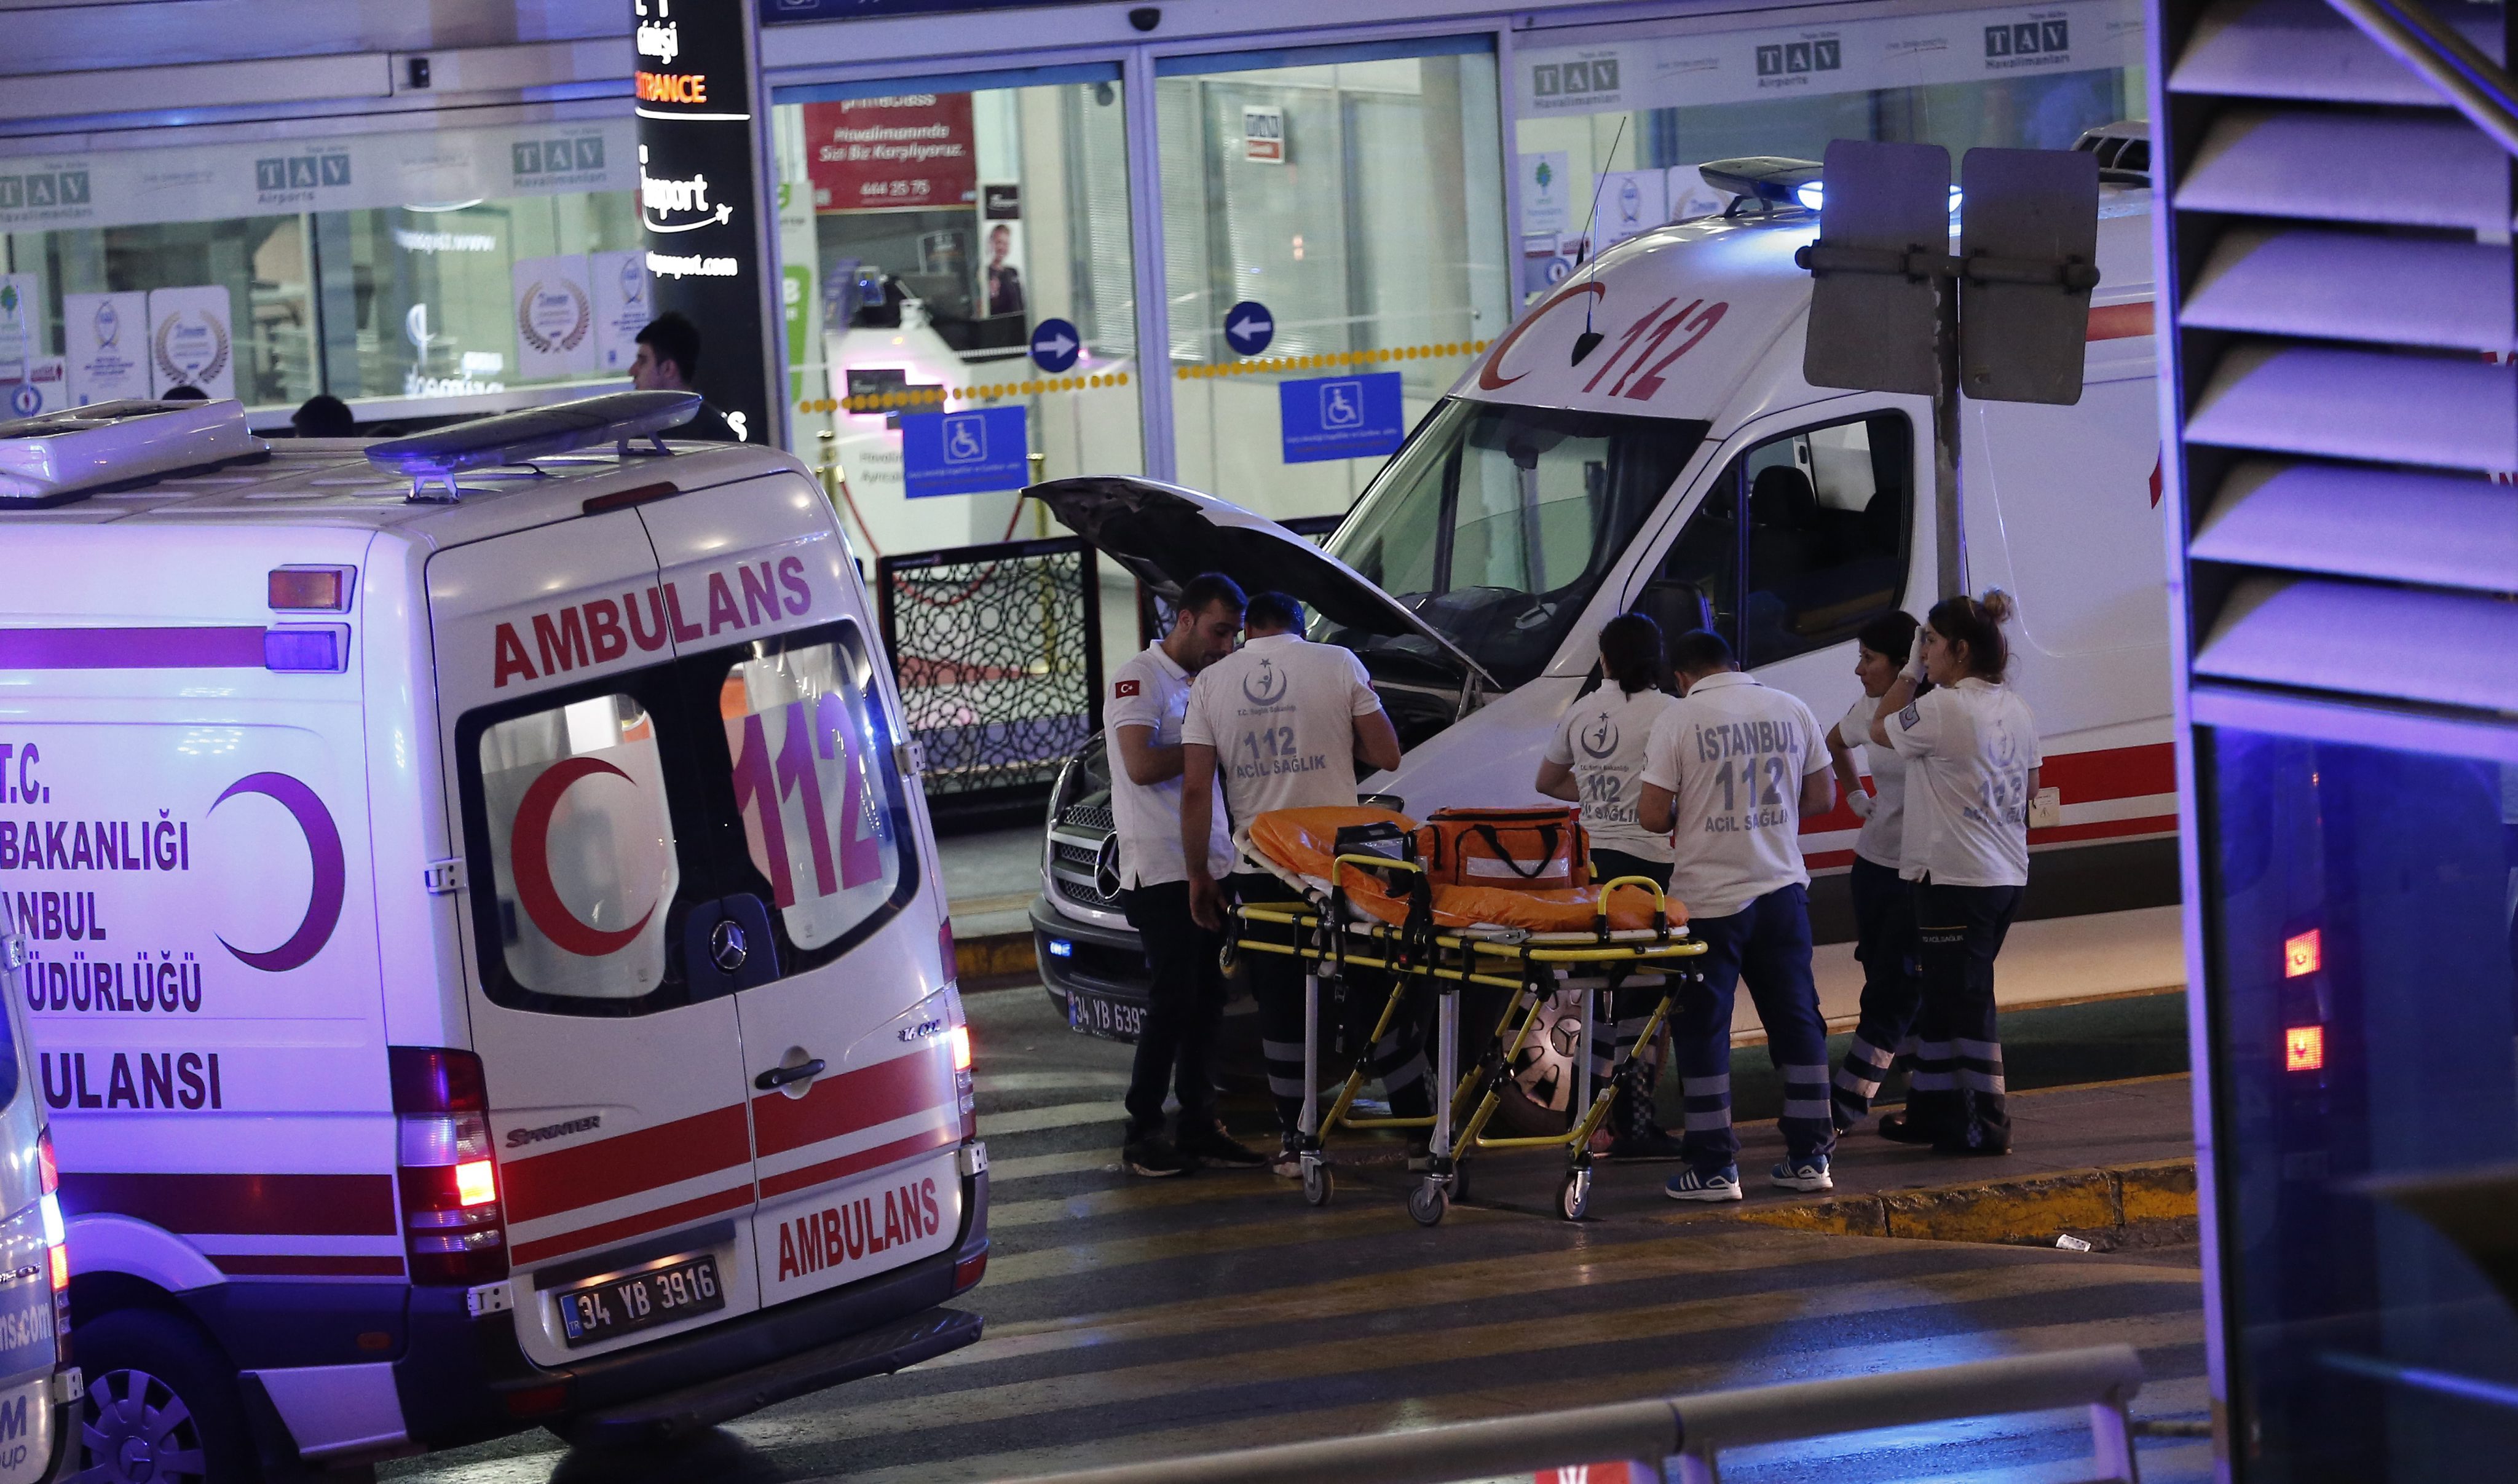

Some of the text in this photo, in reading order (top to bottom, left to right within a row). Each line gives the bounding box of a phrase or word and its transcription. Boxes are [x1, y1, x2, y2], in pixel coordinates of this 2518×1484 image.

[1756, 40, 1840, 75] TAV
[1986, 20, 2068, 57] TAV
[1534, 60, 1619, 97] TAV
[255, 154, 351, 191] TAV
[512, 137, 604, 174] TAV
[1582, 297, 1729, 401] 112
[494, 556, 811, 688] AMBULANS
[1244, 727, 1296, 759] 112
[1695, 721, 1798, 763] İSTANBUL
[0, 743, 50, 804] T.C.
[1274, 756, 1326, 775] SAĞLIK
[1716, 757, 1784, 810] 112
[732, 692, 882, 909] 112
[1589, 775, 1620, 803] 112
[0, 808, 189, 870] BAKANLIĞI
[1075, 996, 1089, 1025] 34
[1093, 999, 1110, 1028] YB
[779, 1177, 939, 1282] AMBULANS
[569, 1265, 716, 1332] TR 34 YB 3916
